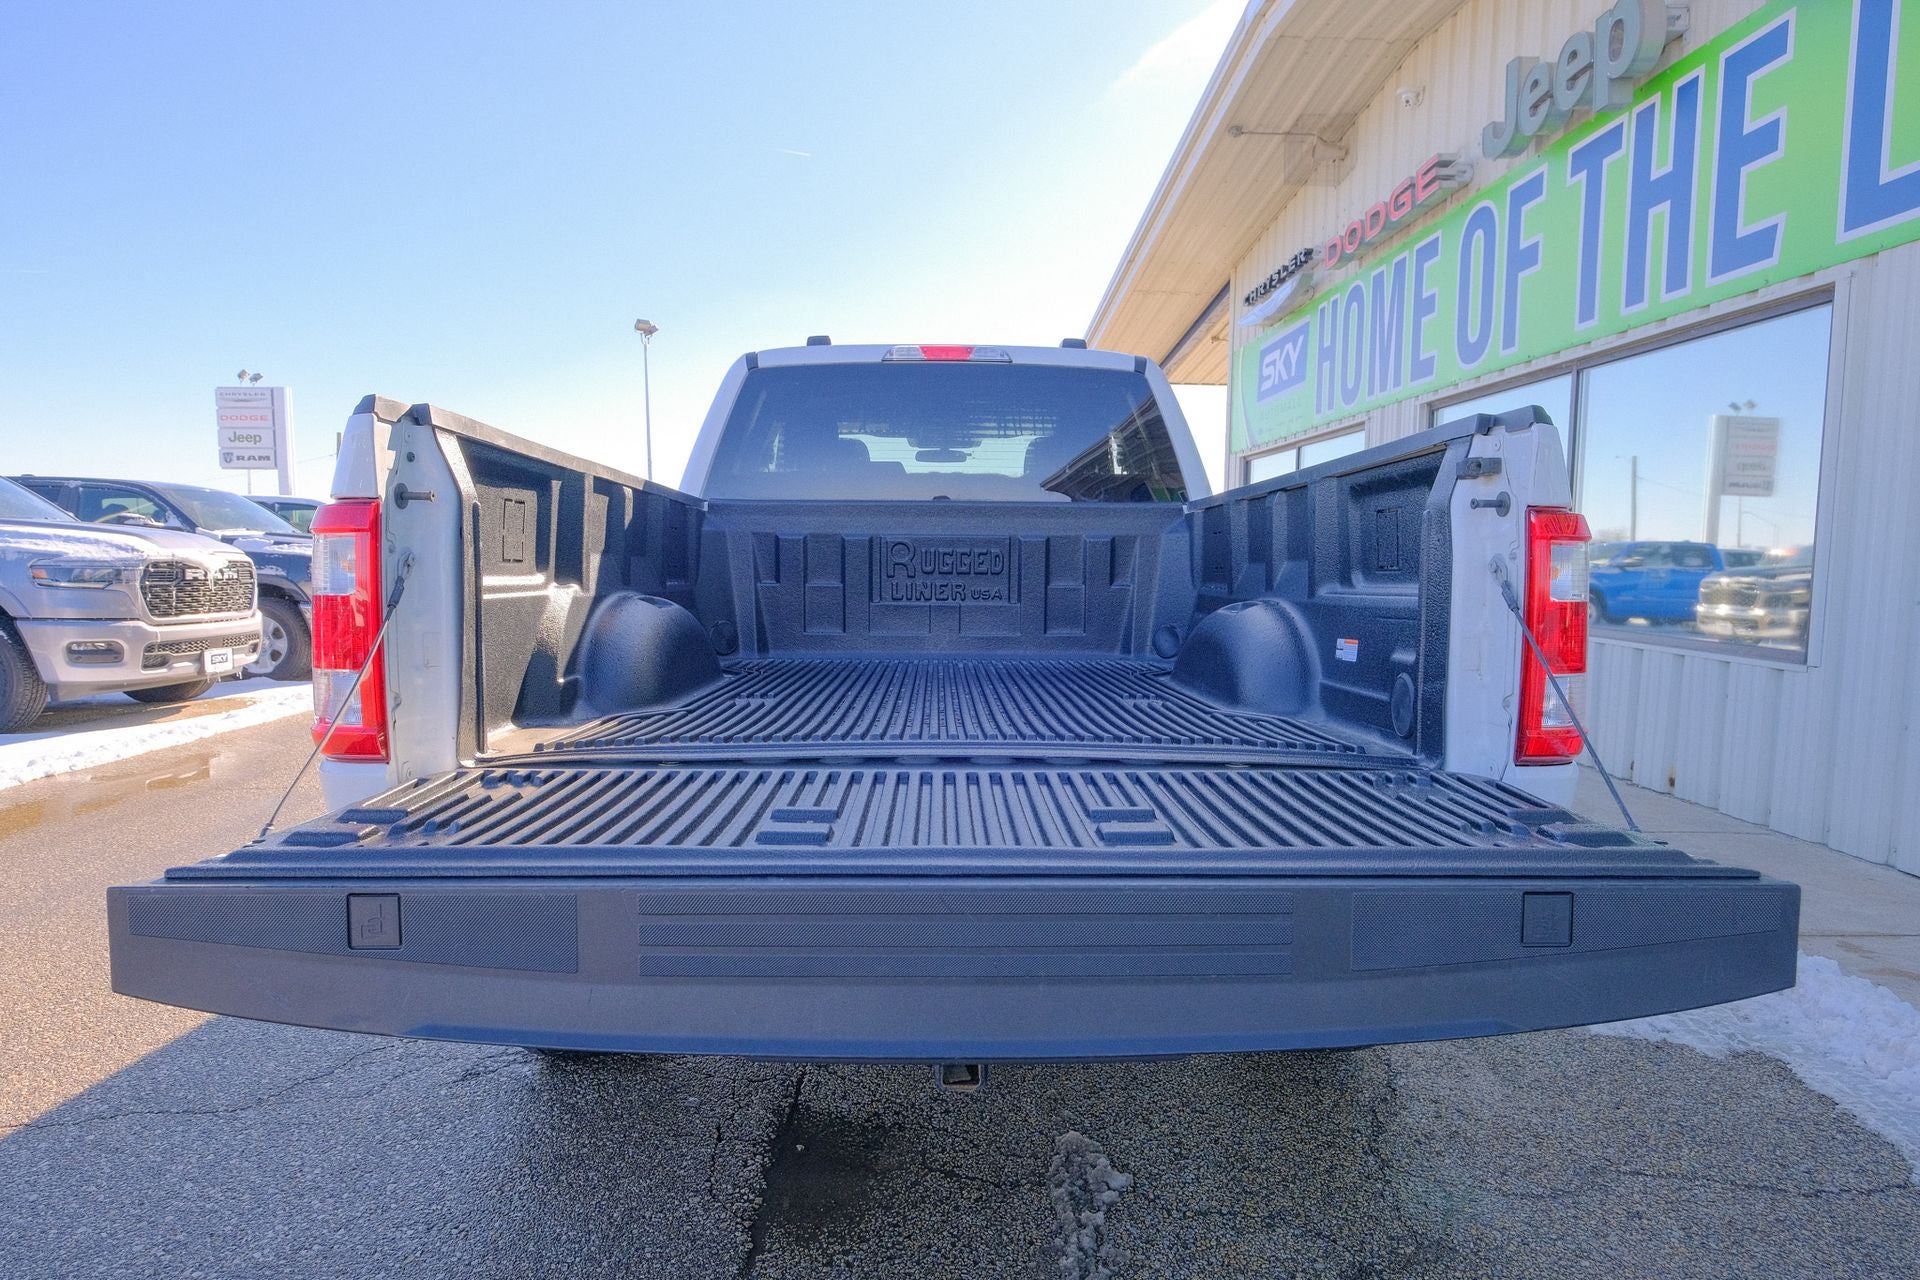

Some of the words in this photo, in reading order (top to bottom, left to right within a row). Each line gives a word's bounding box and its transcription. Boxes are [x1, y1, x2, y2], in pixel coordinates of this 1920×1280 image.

[1482, 0, 1650, 160] Jeep
[1315, 230, 1442, 417] HOME
[1456, 163, 1549, 371] OF
[1566, 7, 1796, 331] THE
[1325, 153, 1443, 269] DODGE
[1242, 248, 1312, 306] CHRYSLER
[1261, 334, 1305, 392] SKY
[228, 431, 262, 445] Jeep
[886, 540, 1005, 578] RUGGED
[891, 582, 966, 601] LINER
[970, 590, 1003, 600] USA
